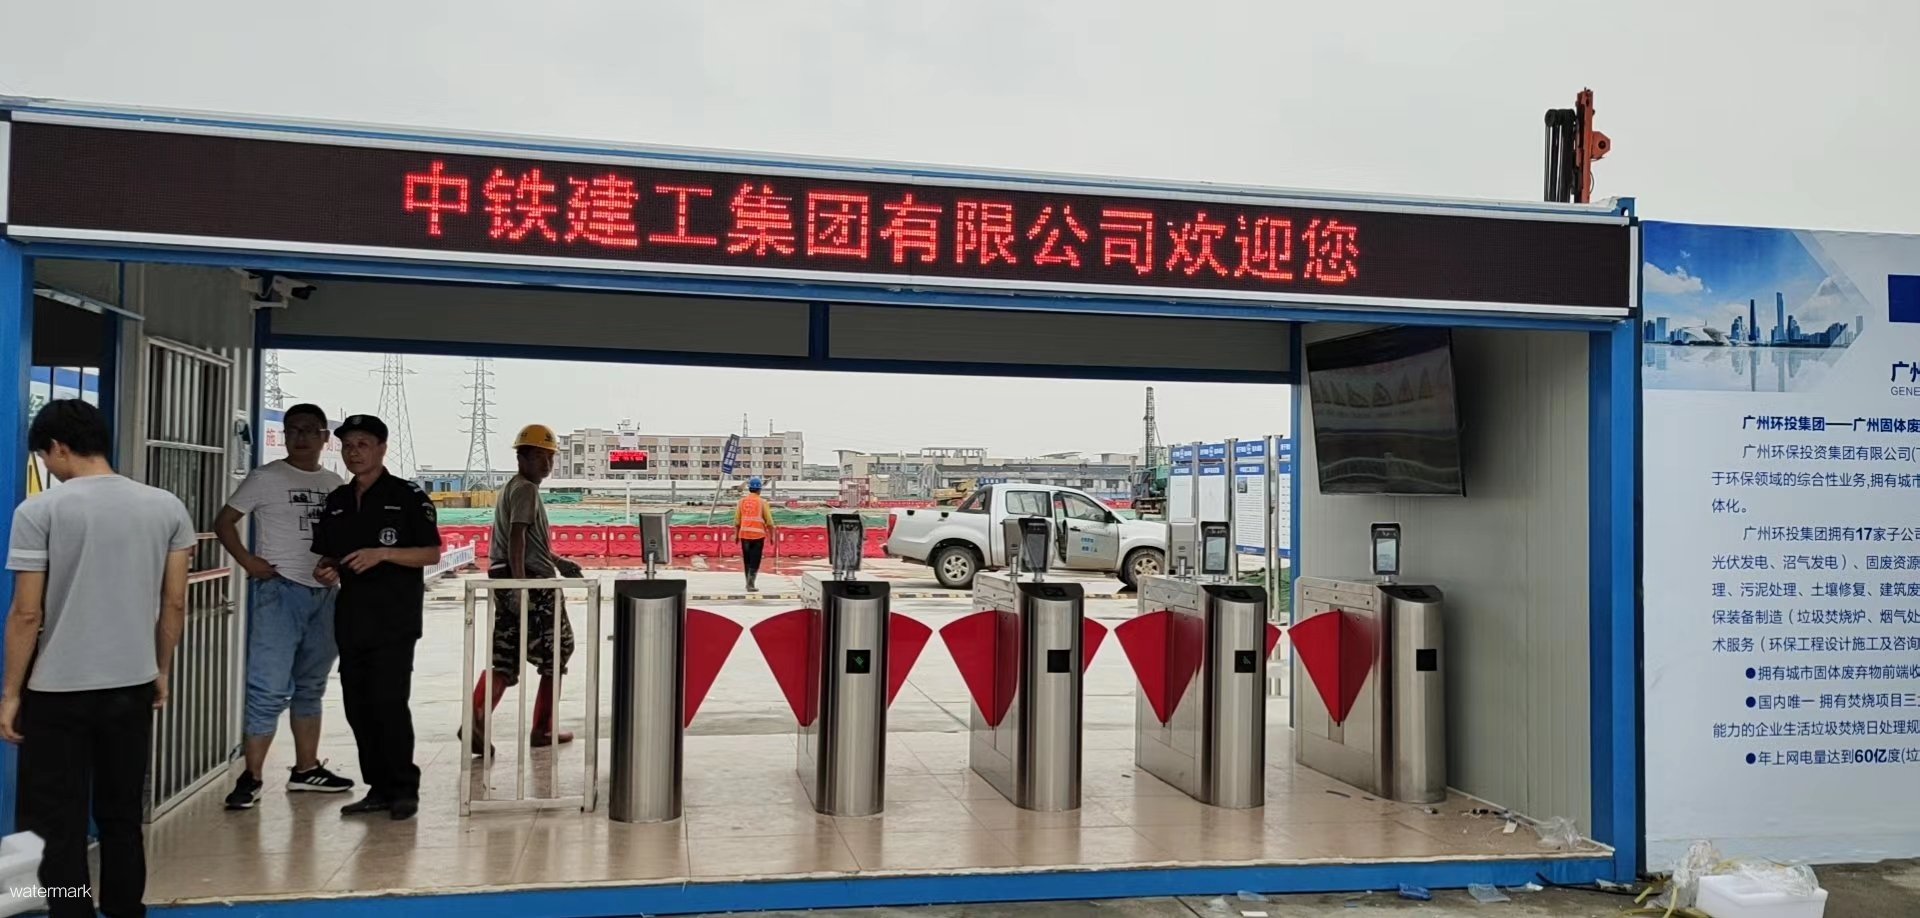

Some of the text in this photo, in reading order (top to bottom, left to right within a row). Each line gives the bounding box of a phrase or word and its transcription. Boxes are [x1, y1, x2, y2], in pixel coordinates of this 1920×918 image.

[403, 161, 1360, 284] 中铁建工集团有限公司欢迎您
[1742, 444, 1920, 462] 广州环保投资集团有限公司(
[1711, 498, 1749, 514] 体化。
